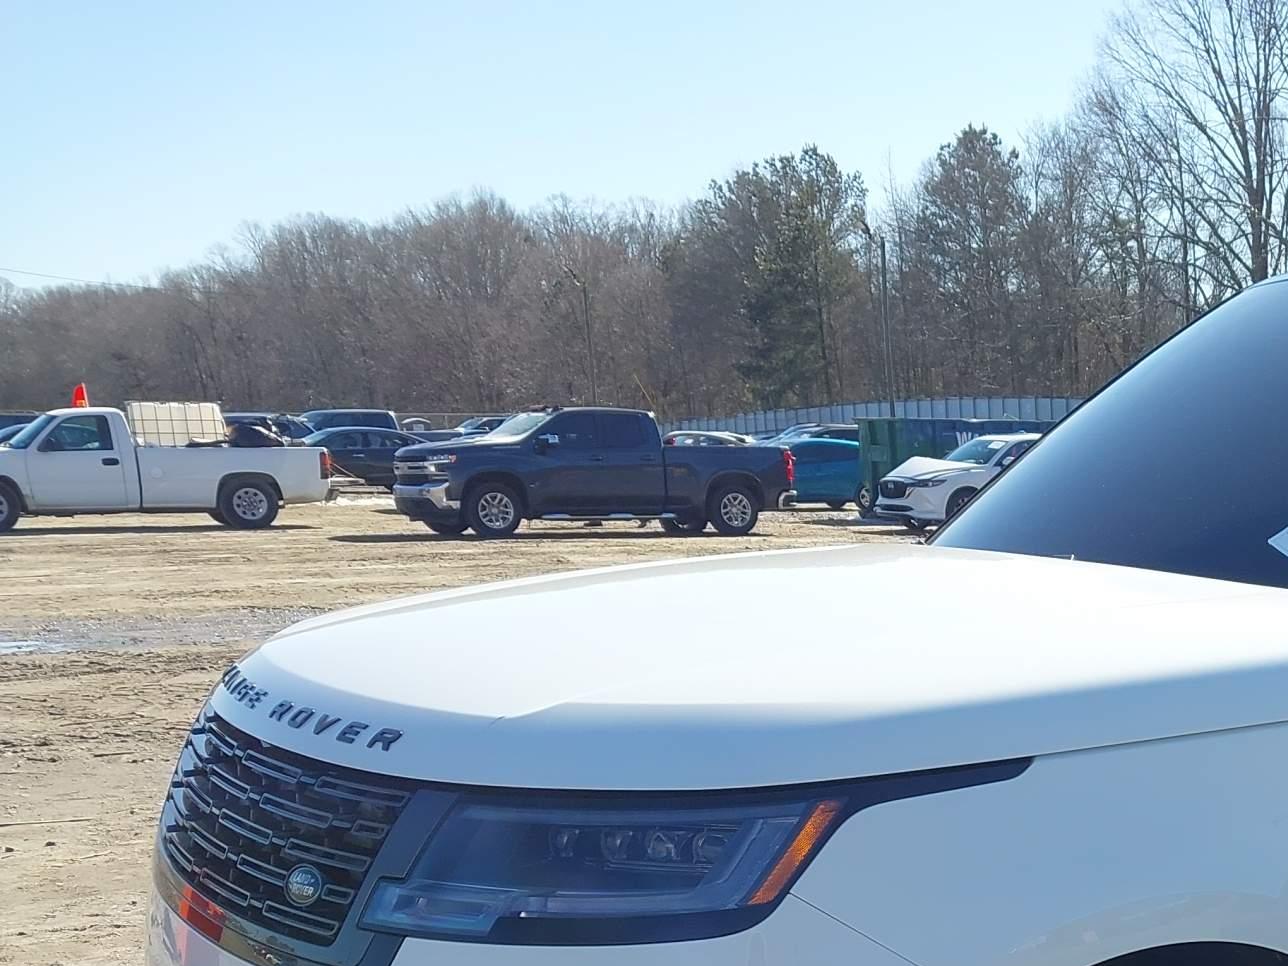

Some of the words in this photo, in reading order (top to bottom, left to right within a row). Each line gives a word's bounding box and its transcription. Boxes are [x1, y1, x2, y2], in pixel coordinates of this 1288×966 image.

[268, 700, 405, 752] ROVER
[291, 871, 311, 885] LAND
[290, 882, 315, 898] ROVER
